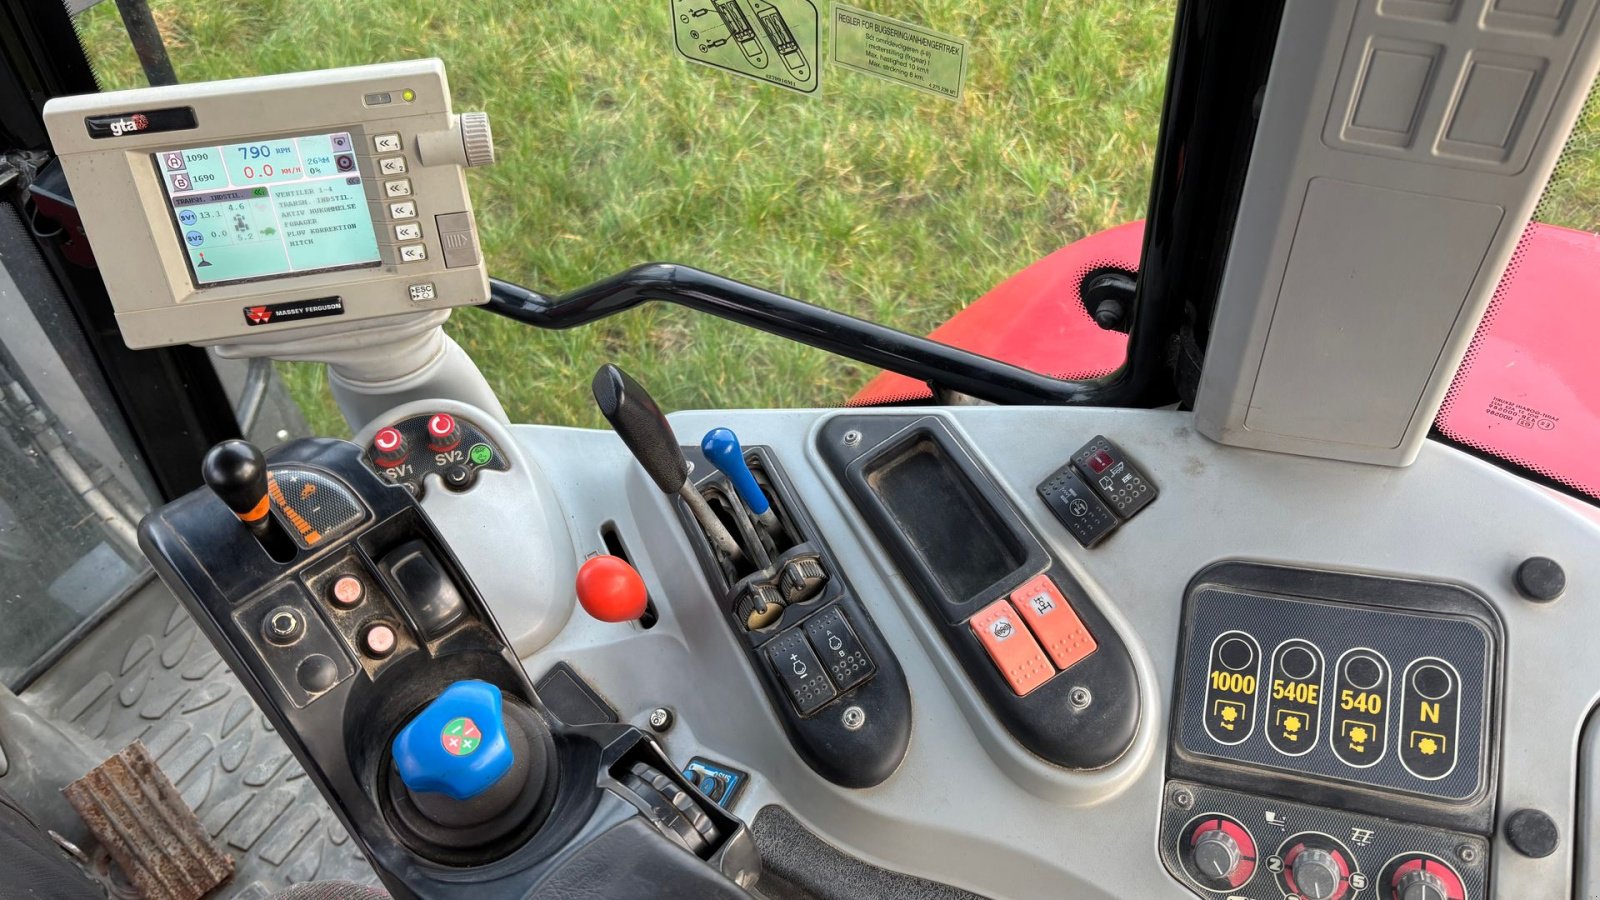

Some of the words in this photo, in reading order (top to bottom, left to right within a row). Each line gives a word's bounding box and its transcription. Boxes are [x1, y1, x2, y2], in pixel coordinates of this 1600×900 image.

[838, 13, 861, 27] REGLER
[861, 20, 874, 30] FOR
[110, 118, 138, 137] gta
[186, 153, 209, 162] 1090
[238, 145, 271, 160] 790
[275, 147, 291, 155] RPM
[193, 174, 215, 183] 1690
[243, 164, 273, 179] 0.0
[275, 188, 314, 198] VENTILER
[200, 210, 222, 219] 13.1
[228, 203, 245, 211] 4.6
[281, 210, 306, 219] AKTIV
[211, 230, 227, 238] 0.0
[287, 229, 306, 238] PLOV
[310, 223, 357, 235] KORREKTION
[290, 239, 314, 247] HITCH
[415, 285, 432, 294] ESC
[275, 308, 304, 316] MASSEY
[305, 303, 342, 313] FERGUSON
[435, 450, 464, 466] SV2
[386, 464, 414, 479] SV1
[1211, 671, 1255, 695] 1000
[1272, 679, 1319, 705] 540E
[1340, 689, 1382, 715] 540
[1420, 701, 1440, 724] N
[1269, 858, 1281, 871] 2
[1352, 874, 1365, 888] 5
